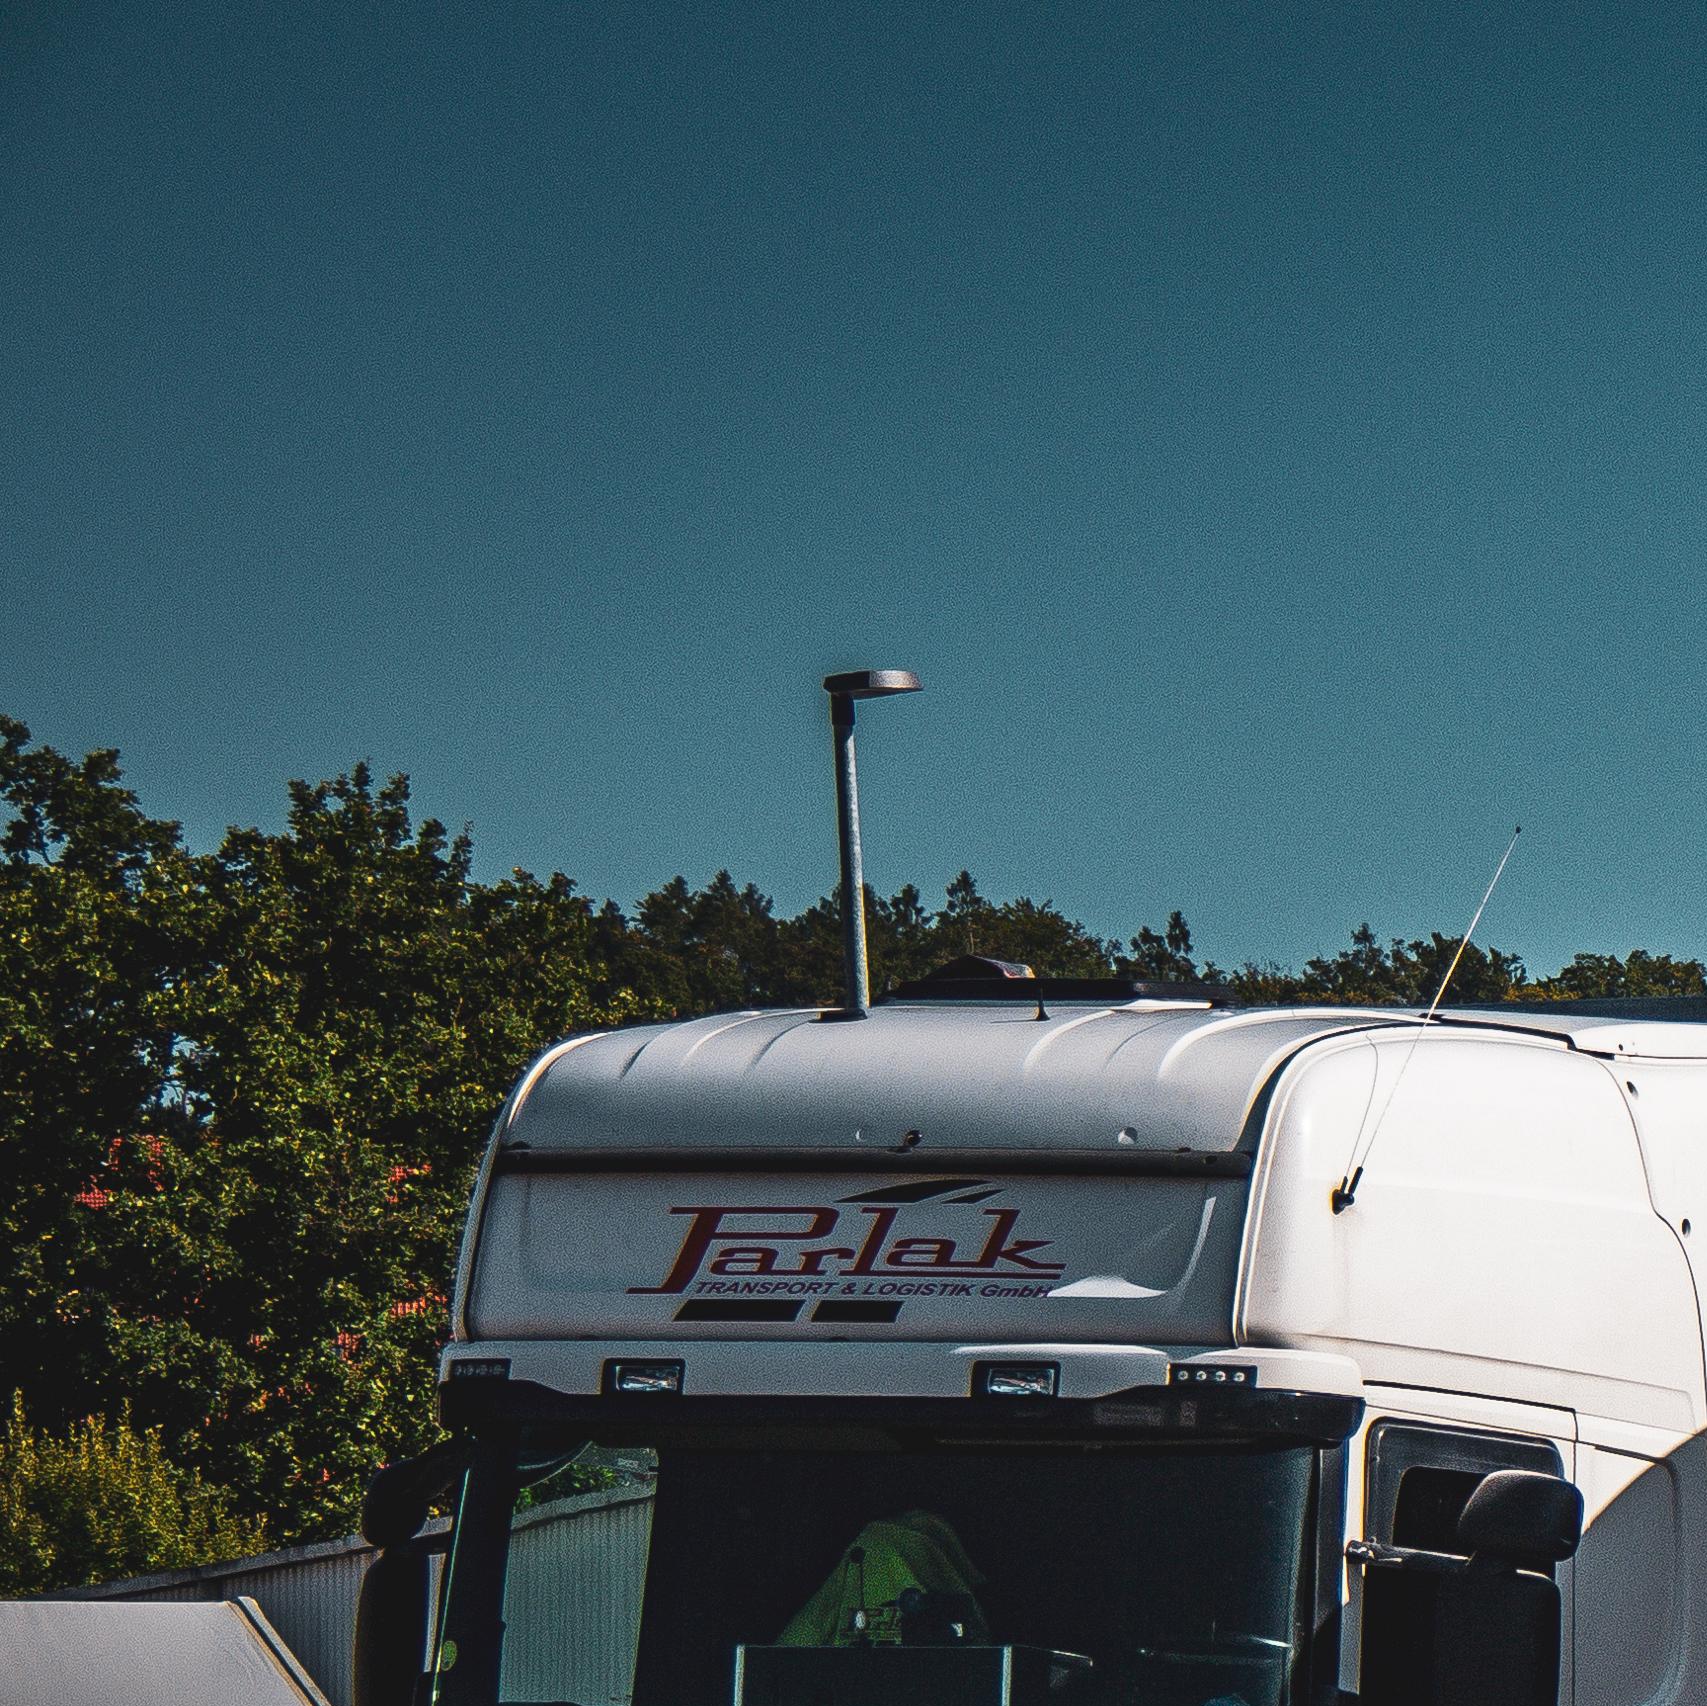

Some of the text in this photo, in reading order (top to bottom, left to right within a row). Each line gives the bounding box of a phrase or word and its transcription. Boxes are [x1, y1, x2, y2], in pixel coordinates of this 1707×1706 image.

[626, 1206, 1067, 1295] Parlak
[697, 1281, 1052, 1299] TRANSPORT & LOGISTIK GmbH
